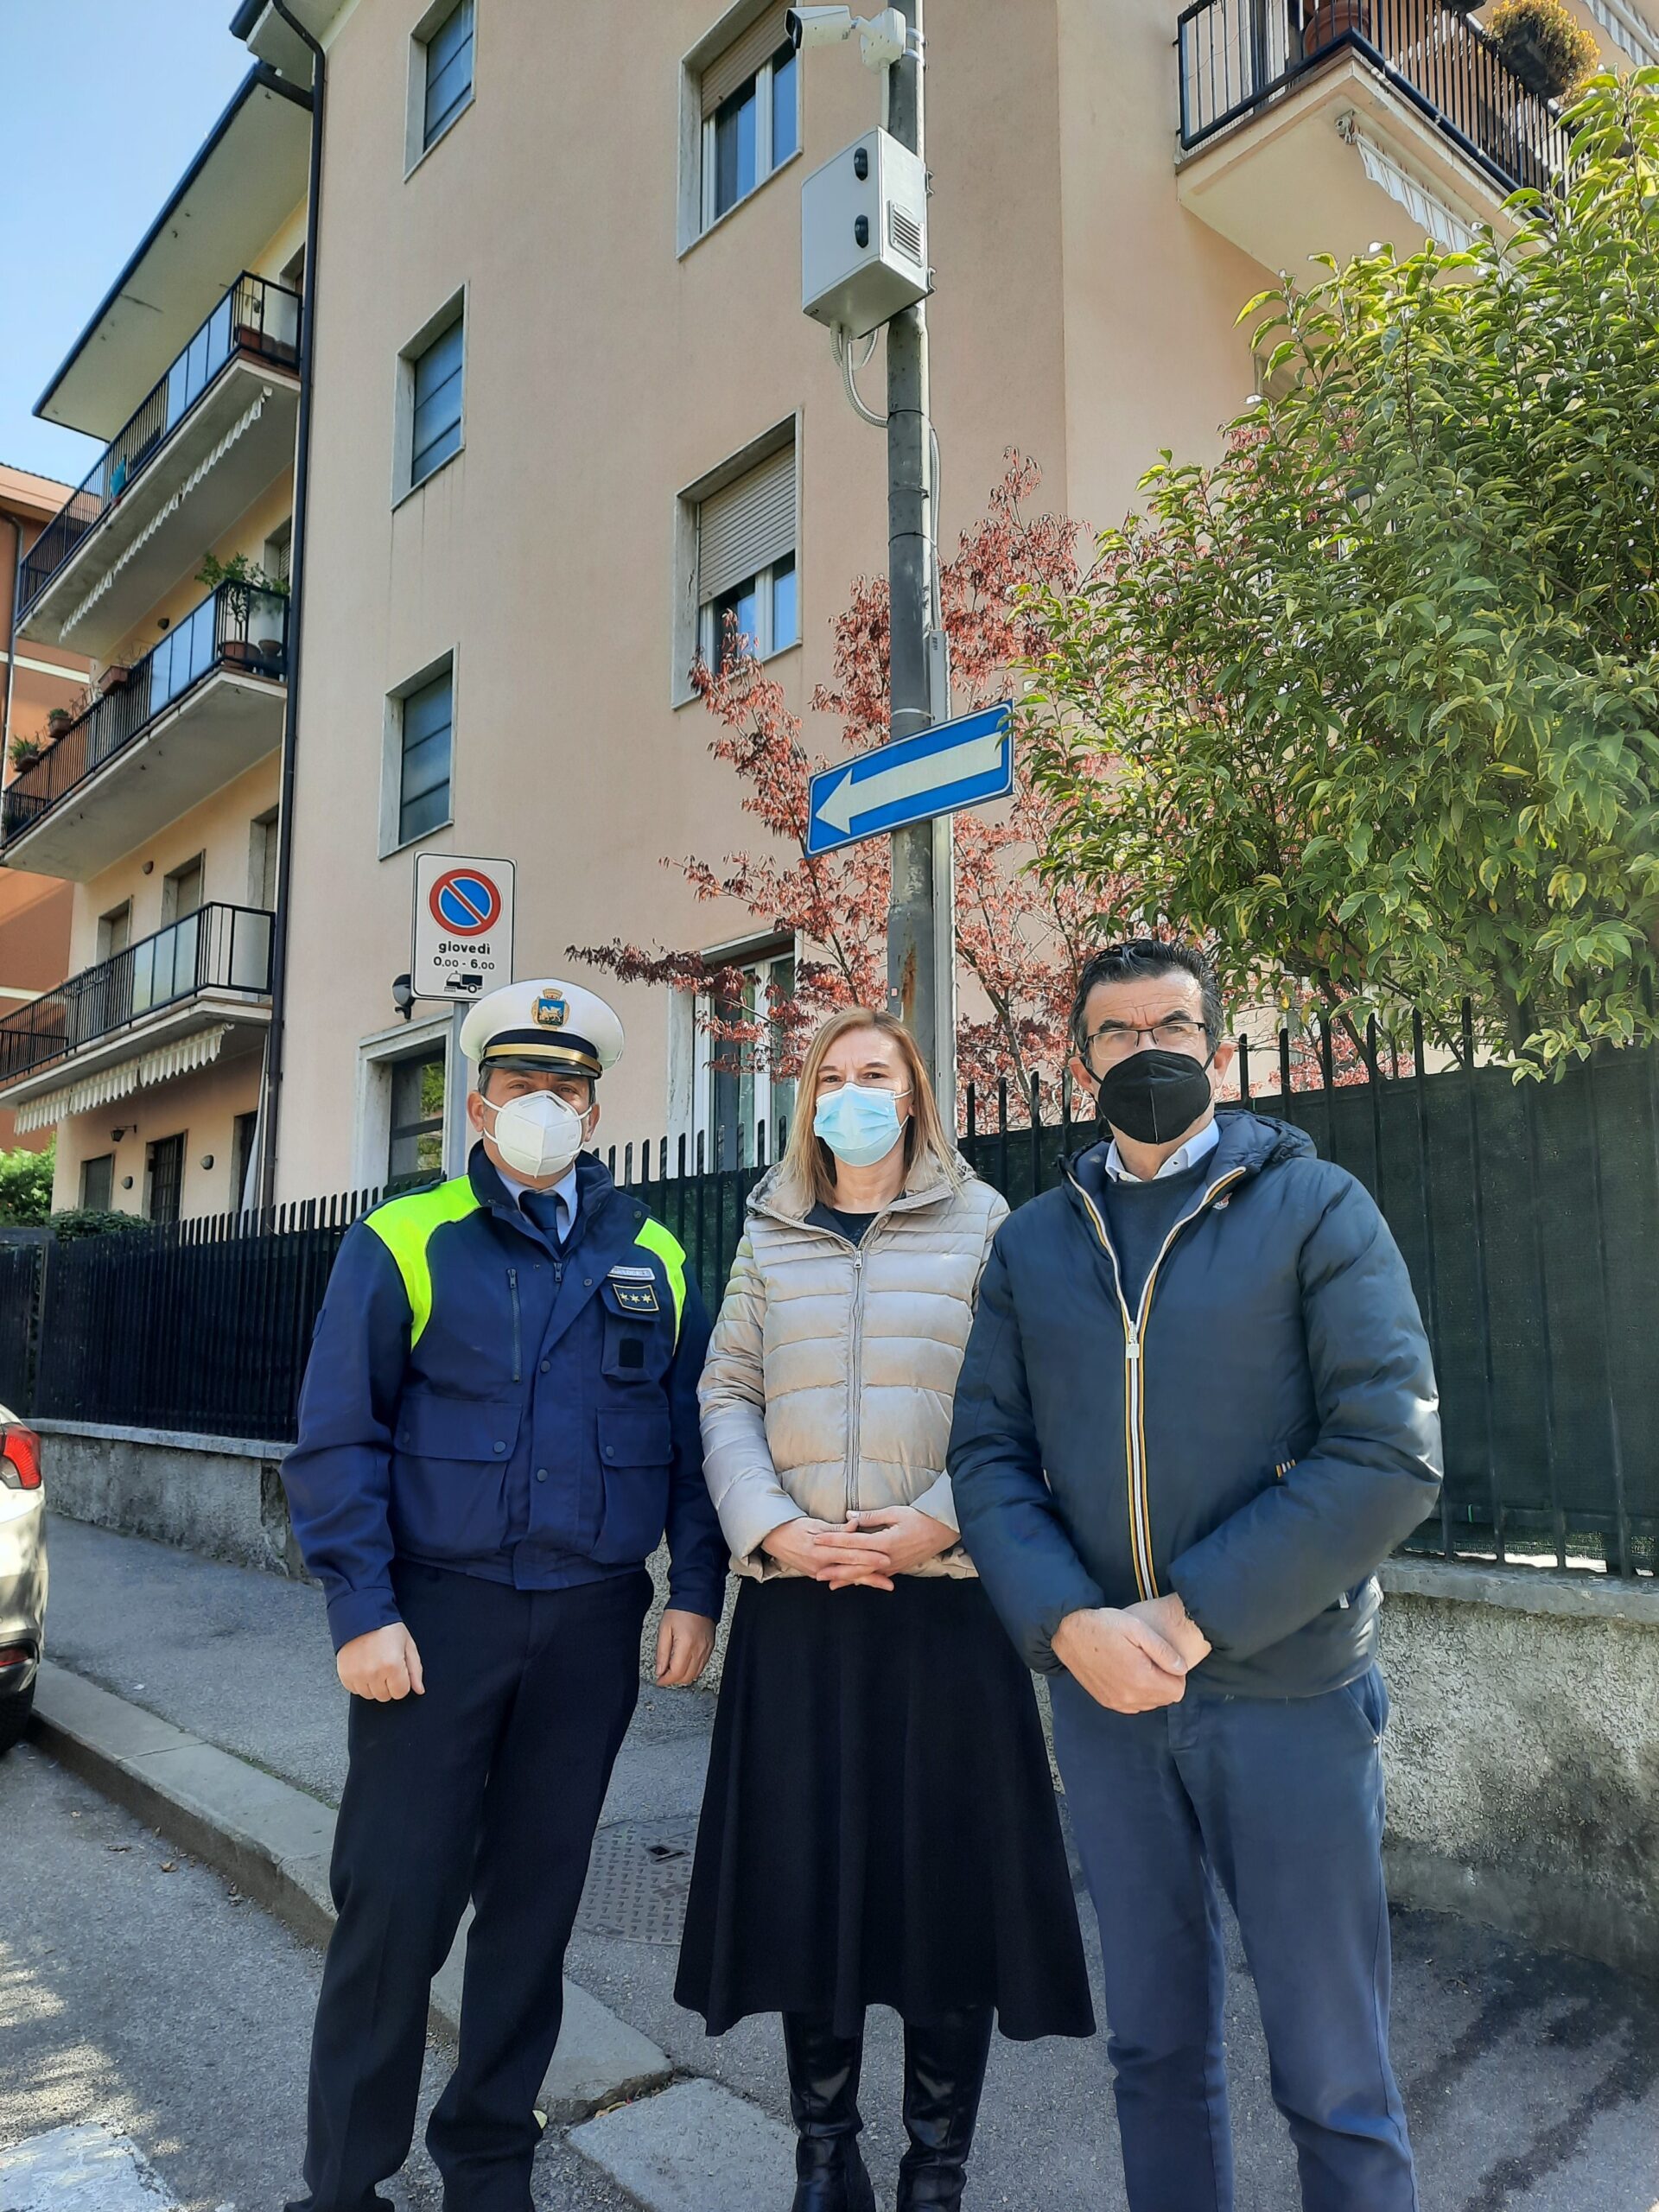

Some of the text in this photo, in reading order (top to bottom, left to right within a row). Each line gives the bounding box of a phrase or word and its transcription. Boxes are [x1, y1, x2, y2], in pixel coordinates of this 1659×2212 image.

[438, 940, 491, 955] giovedì
[433, 956, 459, 968] 0.00
[470, 958, 495, 969] 6.00
